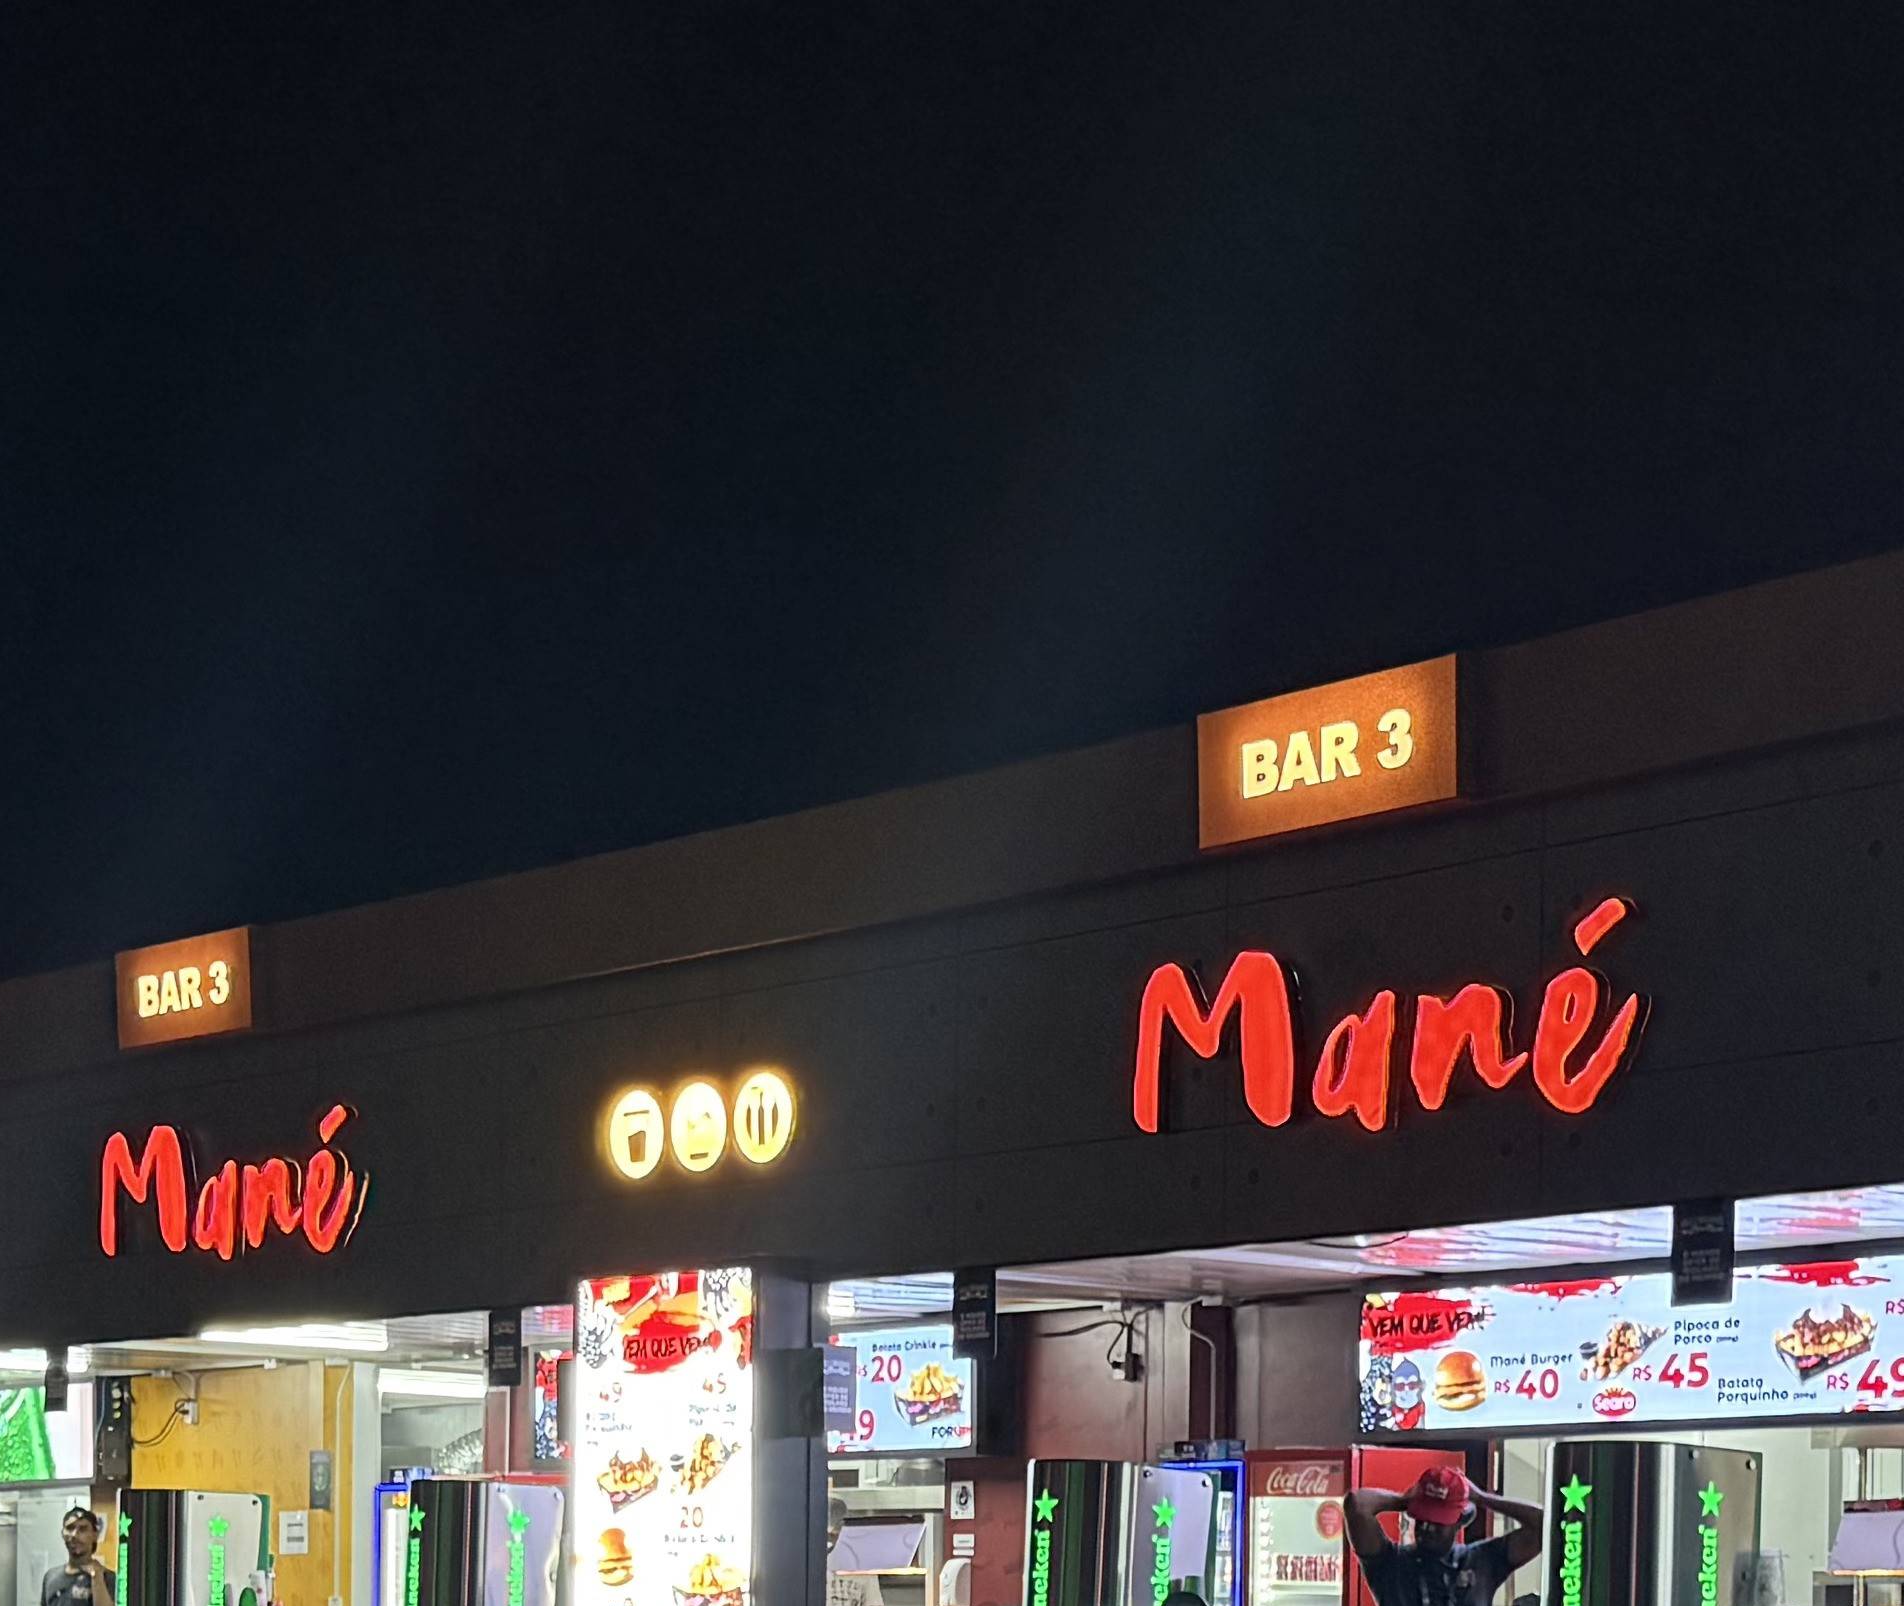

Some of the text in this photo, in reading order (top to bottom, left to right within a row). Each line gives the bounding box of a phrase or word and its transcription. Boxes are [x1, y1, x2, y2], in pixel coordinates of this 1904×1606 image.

[1241, 707, 1414, 799] BAR 3
[137, 960, 230, 1020] BAR 3
[1132, 897, 1640, 1132] Mané
[100, 1104, 355, 1262] Mané
[1409, 1313, 1443, 1335] QUE
[1673, 1316, 1741, 1335] Pipoca de
[650, 1335, 678, 1358] QUE
[1673, 1333, 1713, 1346] Porco
[870, 1354, 903, 1384] 20
[1490, 1352, 1573, 1369] Mané Burger
[1632, 1352, 1710, 1390] R$ 45
[1494, 1368, 1559, 1401] R$ 40
[1717, 1377, 1764, 1391] Batata
[1826, 1373, 1850, 1391] R$
[1717, 1388, 1790, 1405] Porquinho
